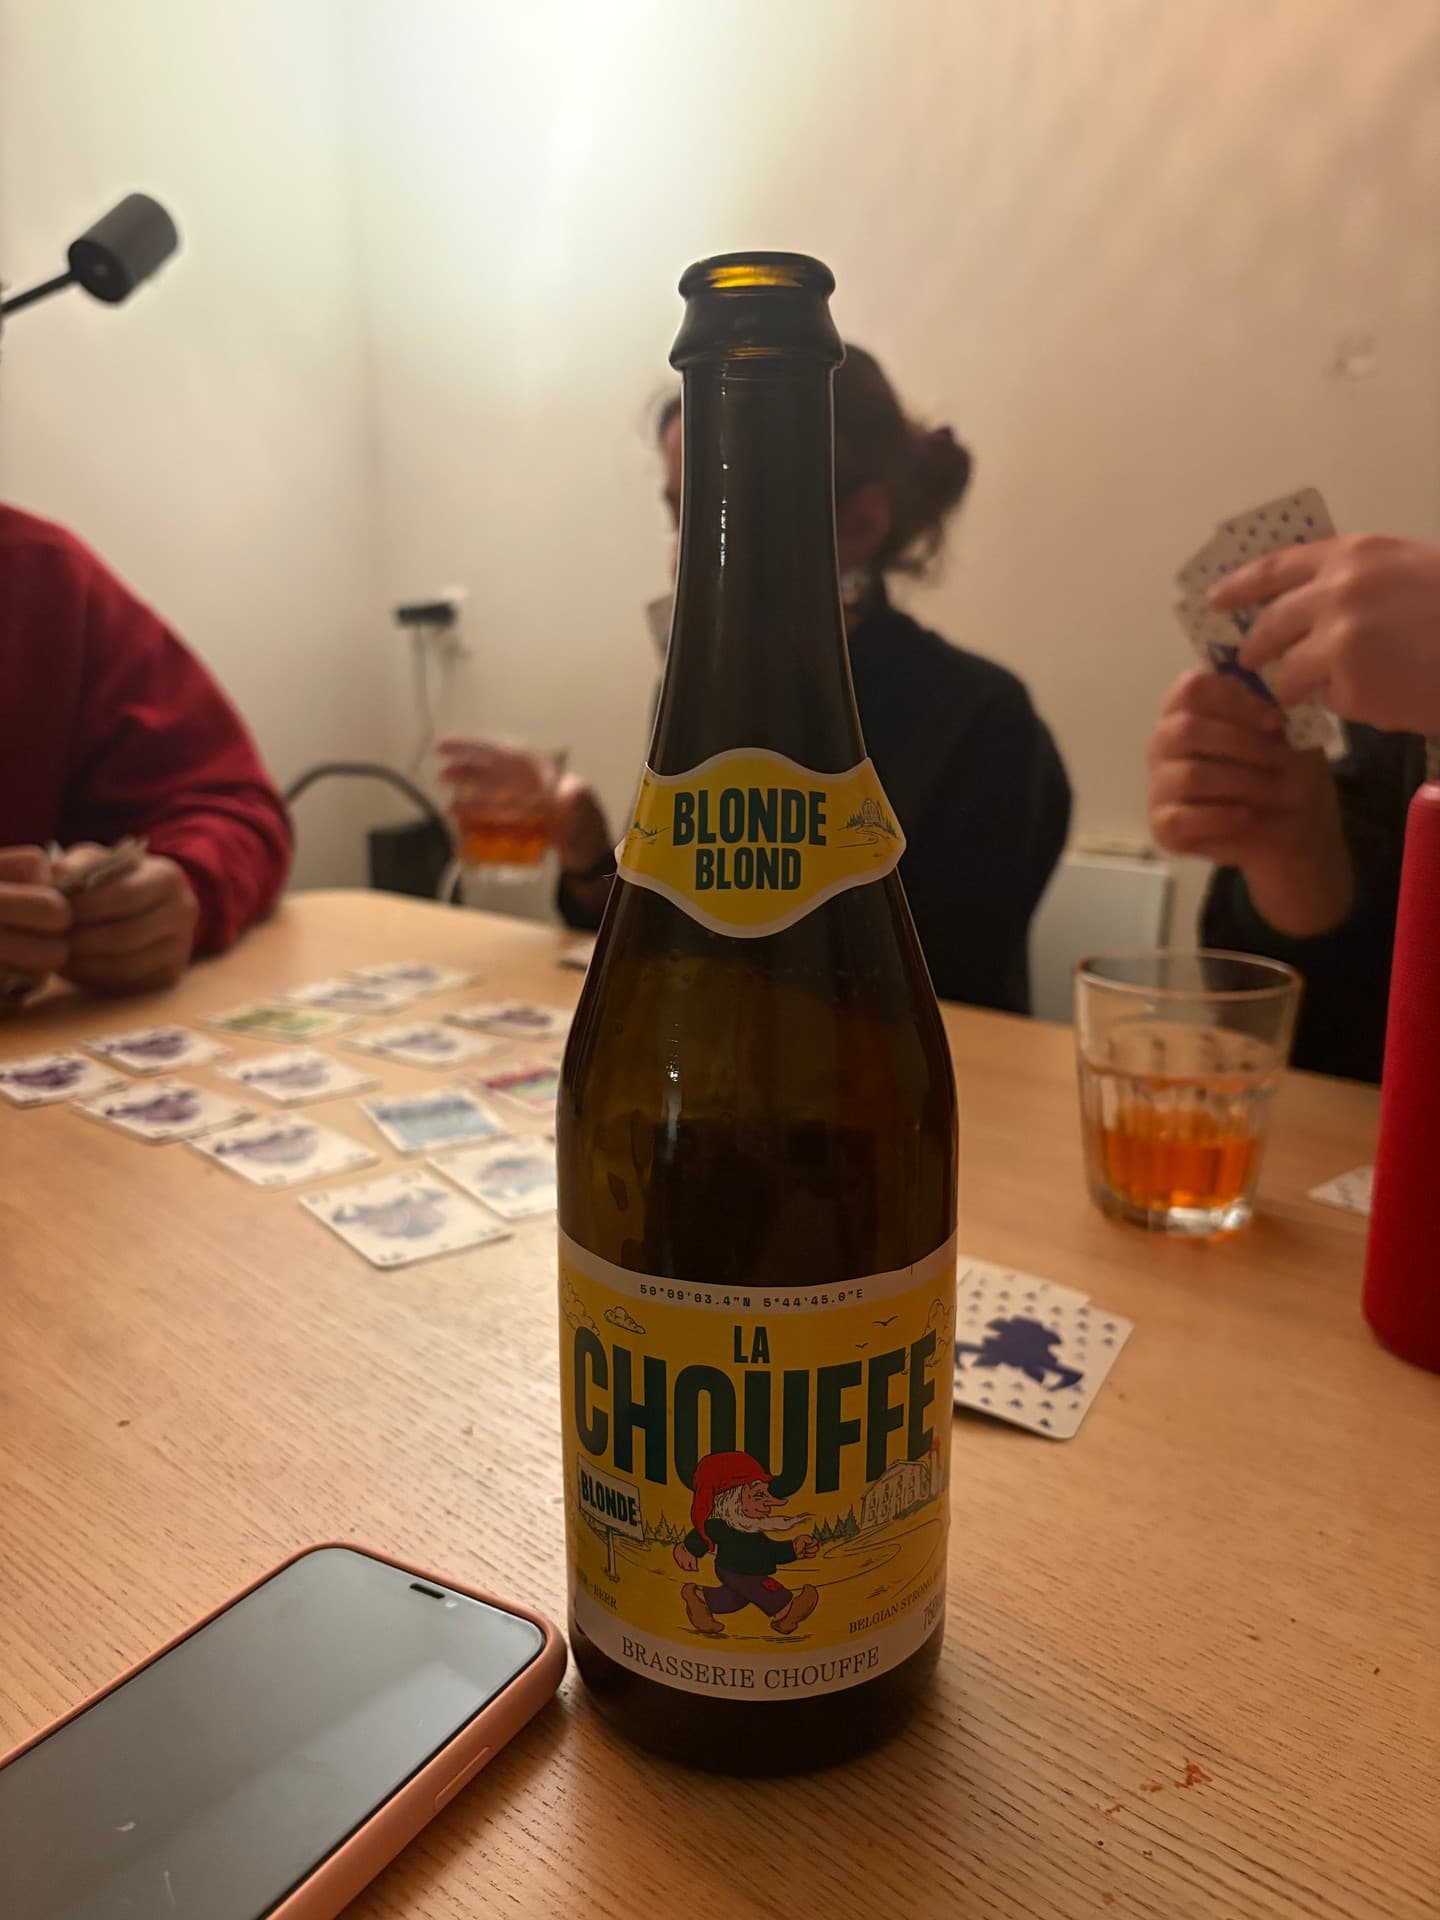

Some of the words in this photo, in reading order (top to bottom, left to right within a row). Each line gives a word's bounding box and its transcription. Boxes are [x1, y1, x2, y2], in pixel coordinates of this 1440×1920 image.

[672, 788, 827, 847] BLONDE
[695, 847, 802, 891] BLOND
[733, 1325, 770, 1364] LA
[574, 1326, 937, 1498] CHOUFFE
[579, 1469, 639, 1528] BLONDE
[848, 1602, 900, 1634] BELGIAN
[621, 1635, 755, 1689] BRASSERIE
[763, 1645, 880, 1689] CHOUFFE
